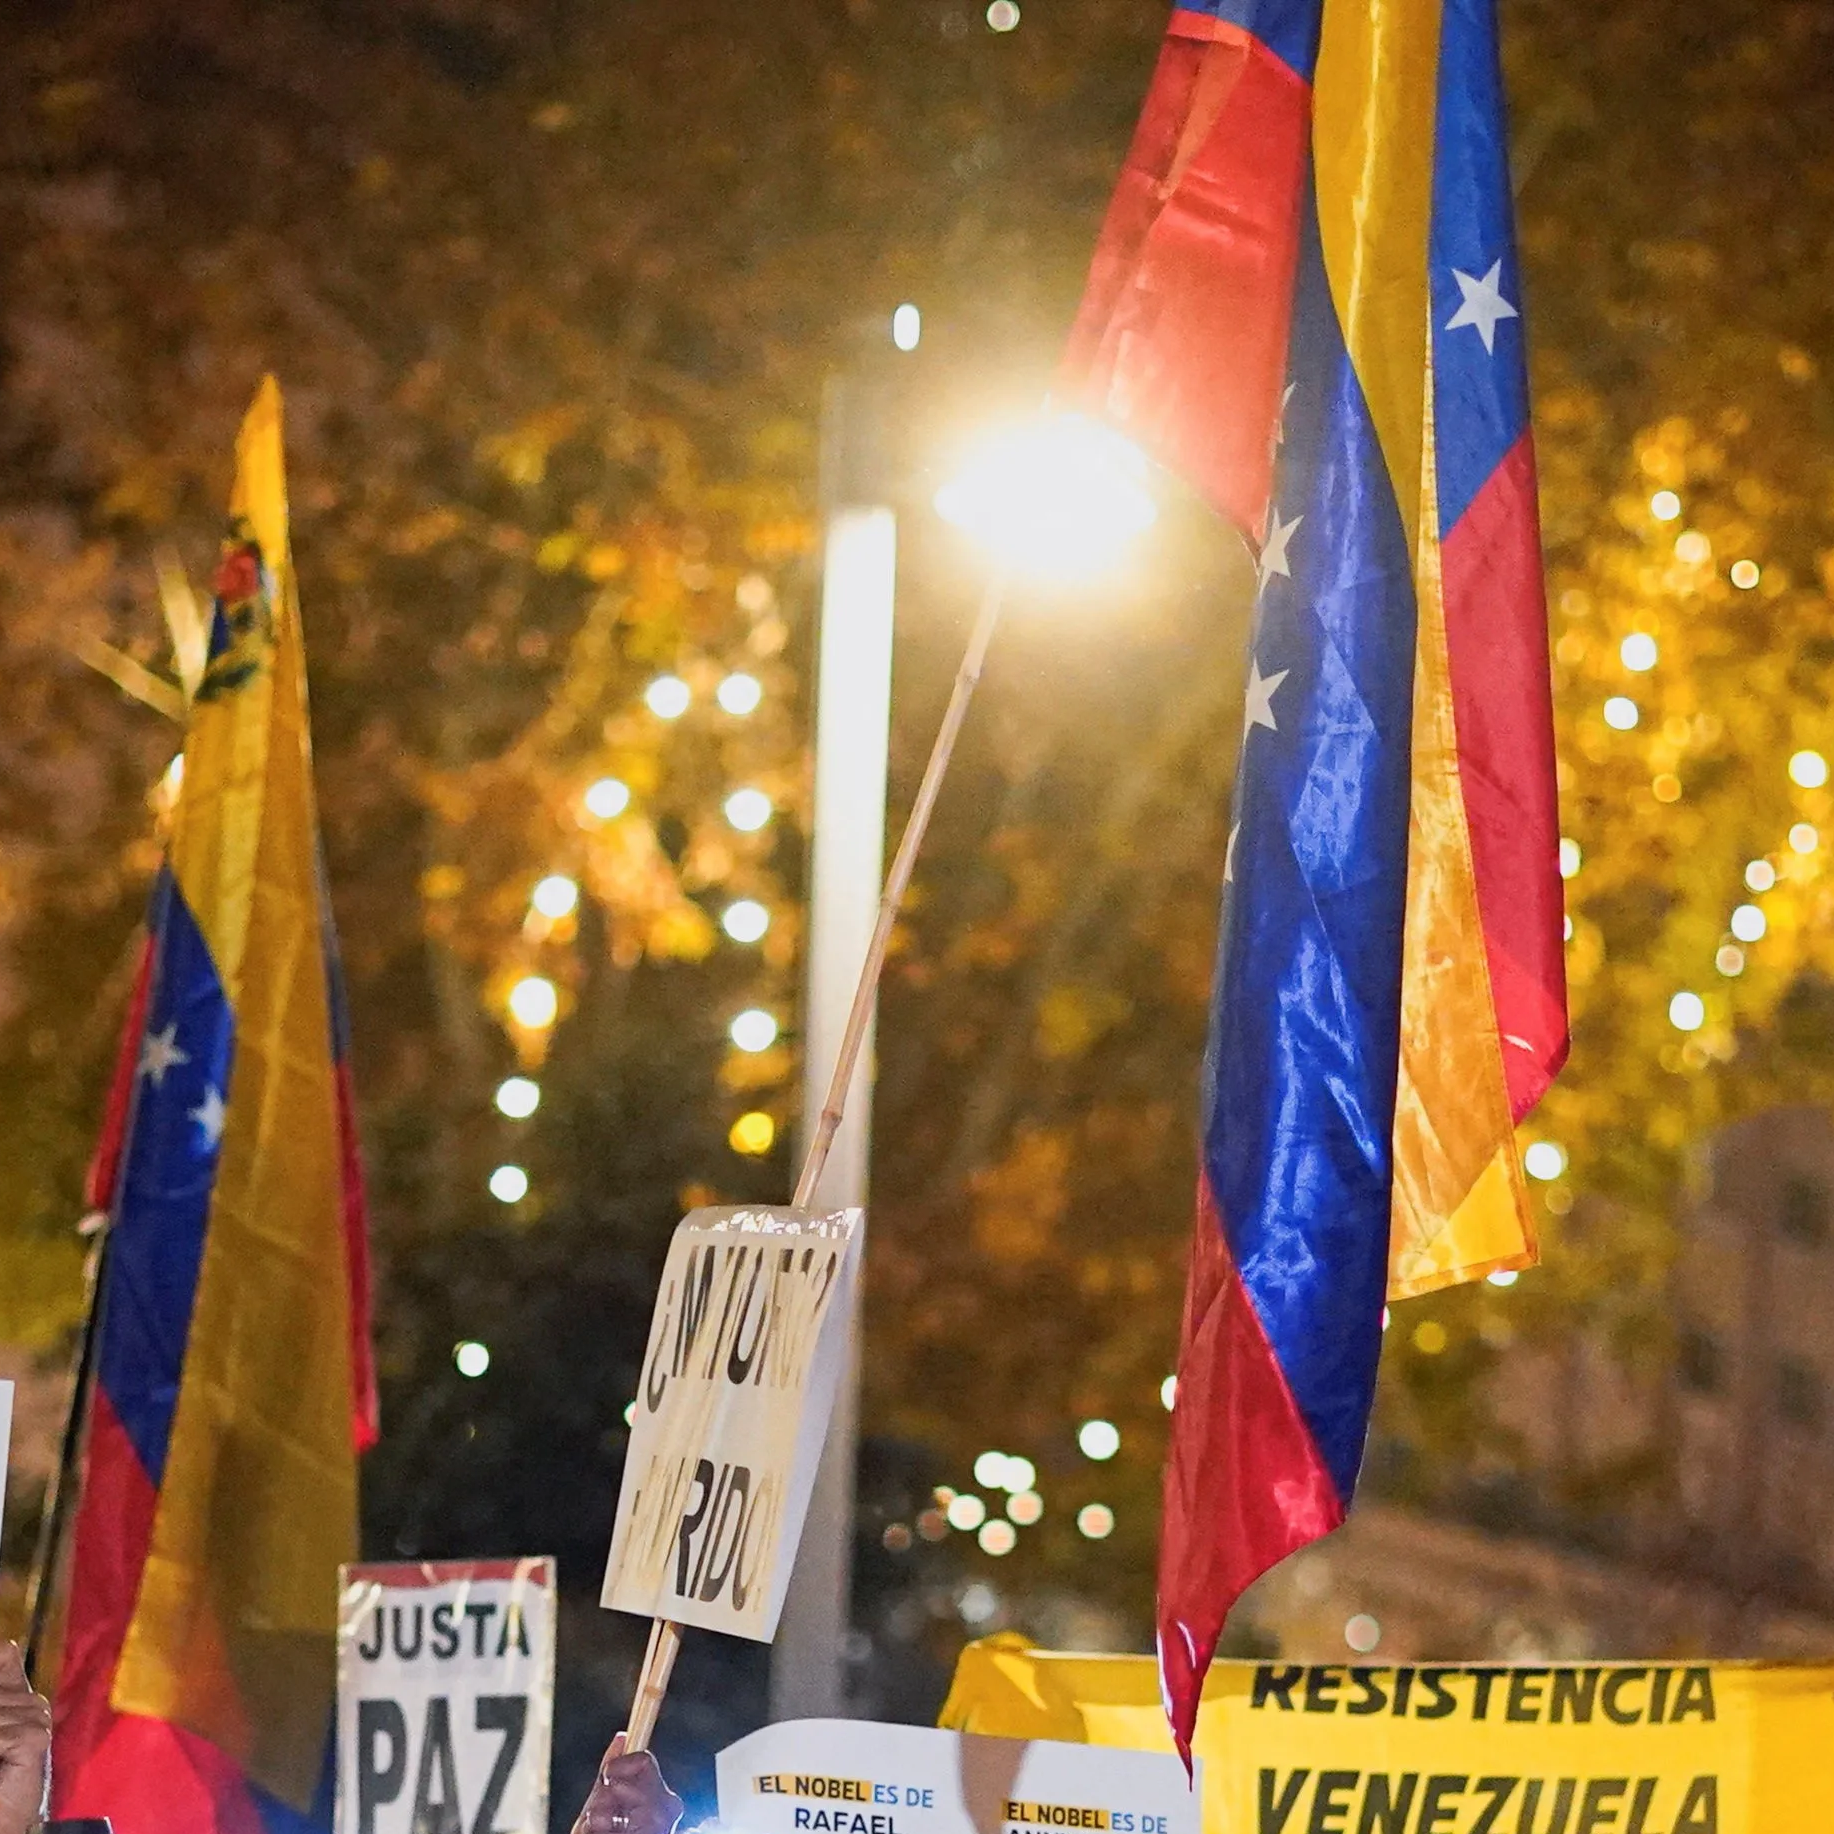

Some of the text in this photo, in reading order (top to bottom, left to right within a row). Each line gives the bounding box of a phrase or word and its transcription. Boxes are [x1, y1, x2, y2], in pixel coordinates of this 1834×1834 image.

[359, 1602, 531, 1662] JUSTA
[1250, 1664, 1716, 1726] RESISTENCIA
[760, 1775, 933, 1809] EL NOBEL ES DE
[1007, 1802, 1032, 1823] EL
[1037, 1804, 1105, 1830] NOBEL
[1111, 1812, 1134, 1833] ES
